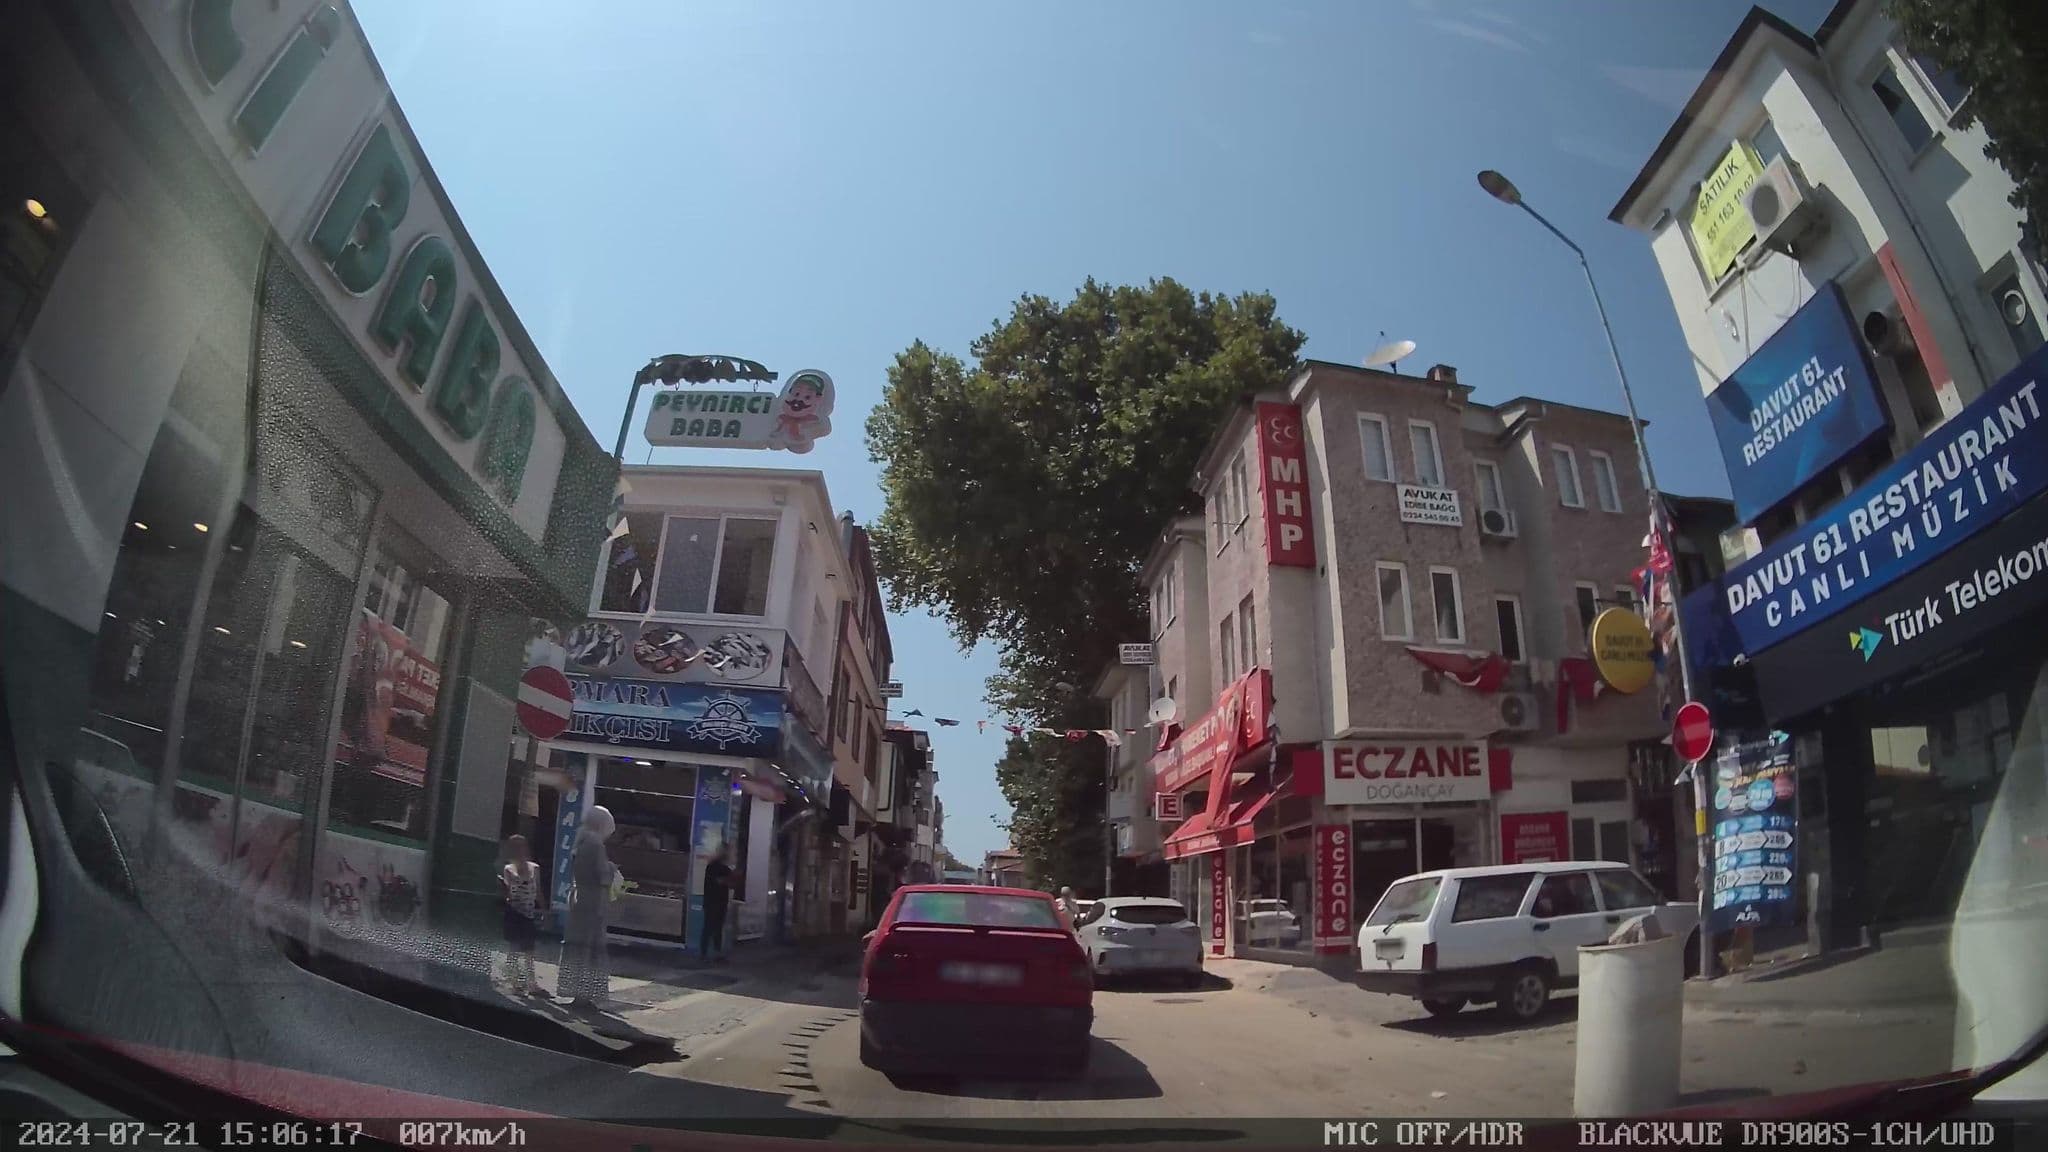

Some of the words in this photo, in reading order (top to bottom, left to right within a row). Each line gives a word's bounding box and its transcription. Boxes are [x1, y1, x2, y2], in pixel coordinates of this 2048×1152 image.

[1699, 158, 1739, 216] SATILIK
[669, 417, 742, 439] BABA
[1743, 365, 1847, 467] RESTAURANT
[1750, 373, 1801, 433] DAVUT
[1802, 355, 1825, 387] 61
[1271, 456, 1303, 551] MHP
[1727, 543, 1806, 615] DAVUT
[1812, 524, 1848, 564] 61
[1849, 380, 2042, 544] RESTAURANT
[1766, 550, 1871, 628] CANLI
[1891, 455, 2018, 559] MÜZİK
[1885, 596, 1944, 646] Türk
[1945, 536, 2048, 616] Telekom
[1164, 799, 1178, 815] E
[1333, 746, 1482, 779] ECZANE
[1331, 831, 1347, 932] eczane
